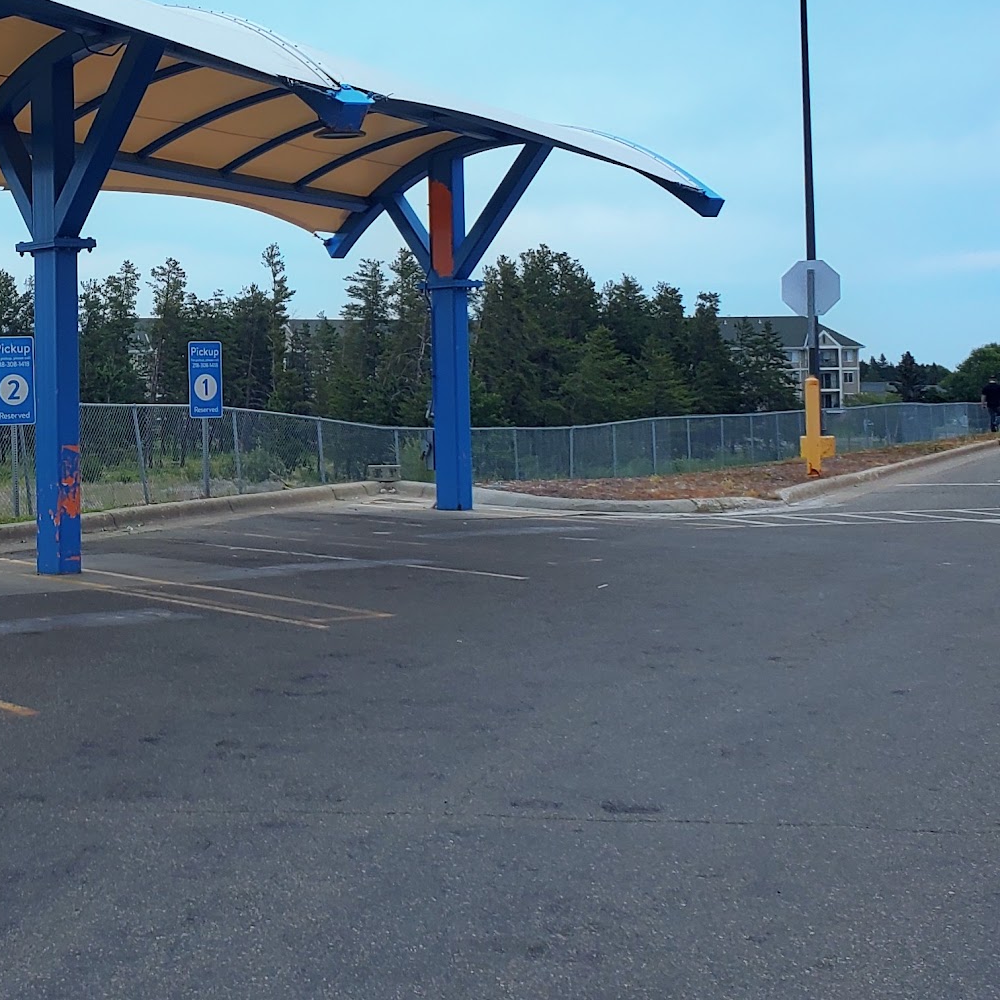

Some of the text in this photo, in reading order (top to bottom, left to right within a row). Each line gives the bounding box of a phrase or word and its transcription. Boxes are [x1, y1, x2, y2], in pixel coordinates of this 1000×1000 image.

[190, 346, 219, 358] Pickup
[7, 379, 20, 400] 2
[202, 378, 208, 396] 1
